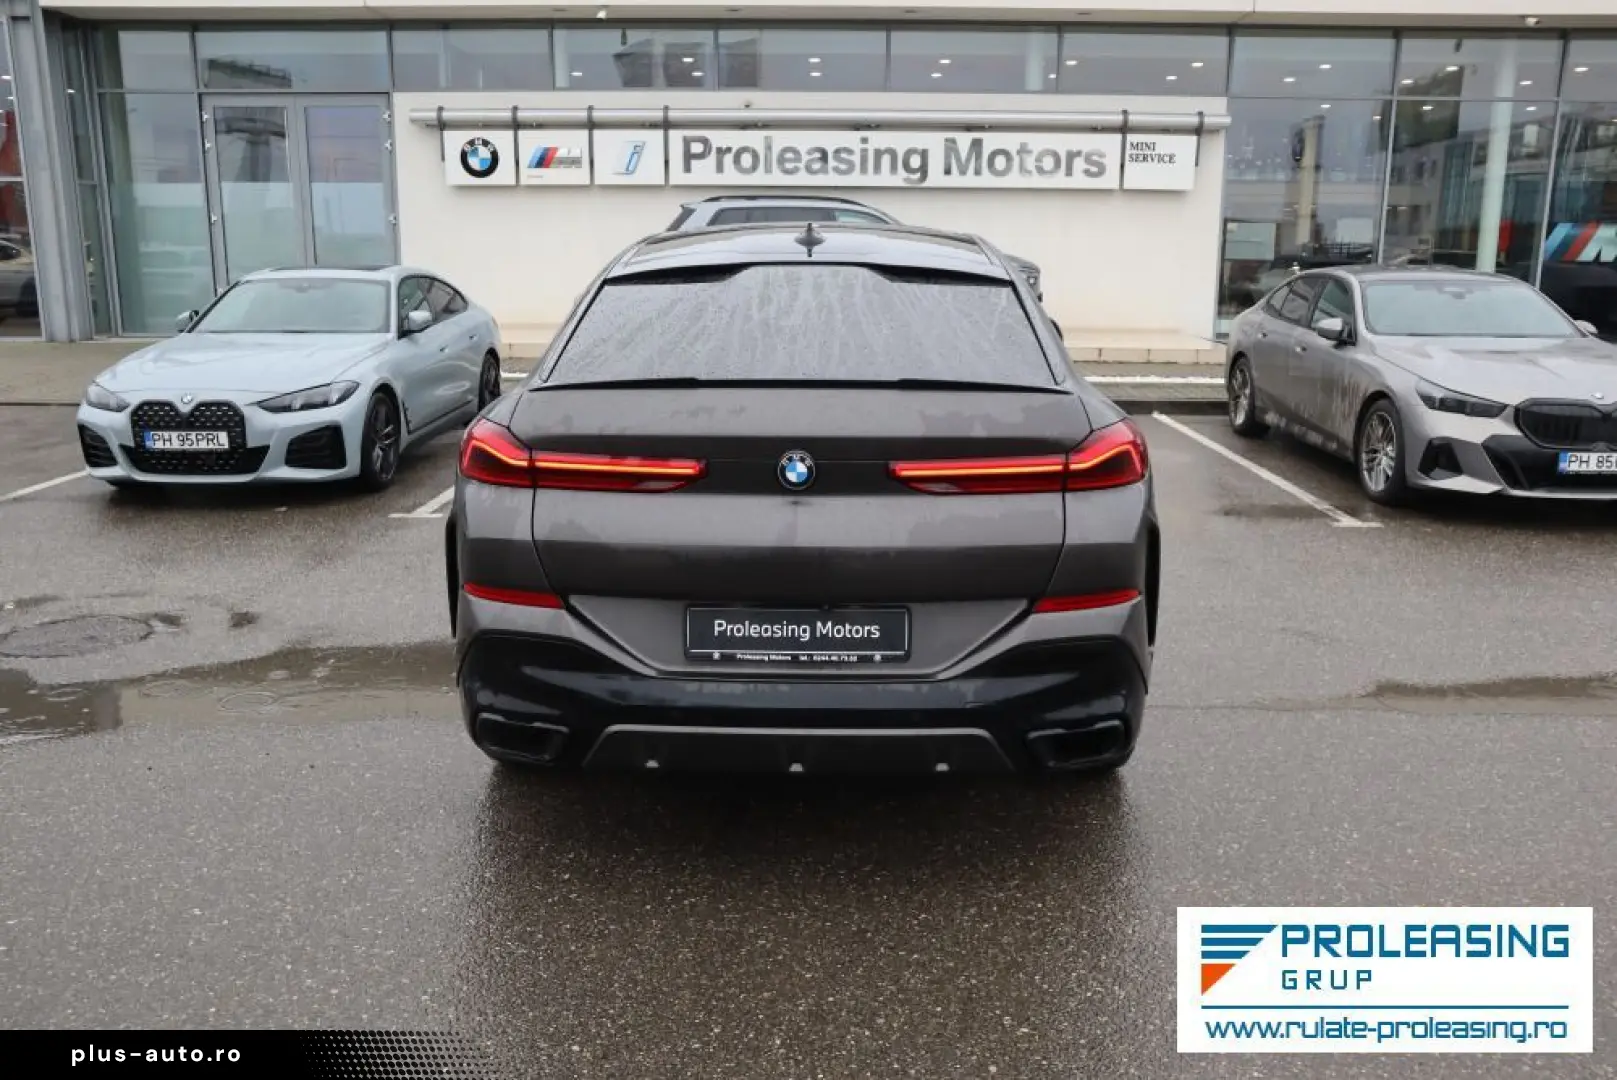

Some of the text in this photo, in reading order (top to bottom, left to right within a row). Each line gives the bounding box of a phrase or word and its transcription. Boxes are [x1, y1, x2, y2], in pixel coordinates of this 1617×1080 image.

[1130, 141, 1156, 151] MINI
[682, 135, 1107, 185] Proleasing Motors
[1128, 152, 1177, 164] SERVICE
[151, 432, 173, 447] PH
[1568, 454, 1617, 470] PH 85
[713, 619, 880, 641] Proleasing Motors
